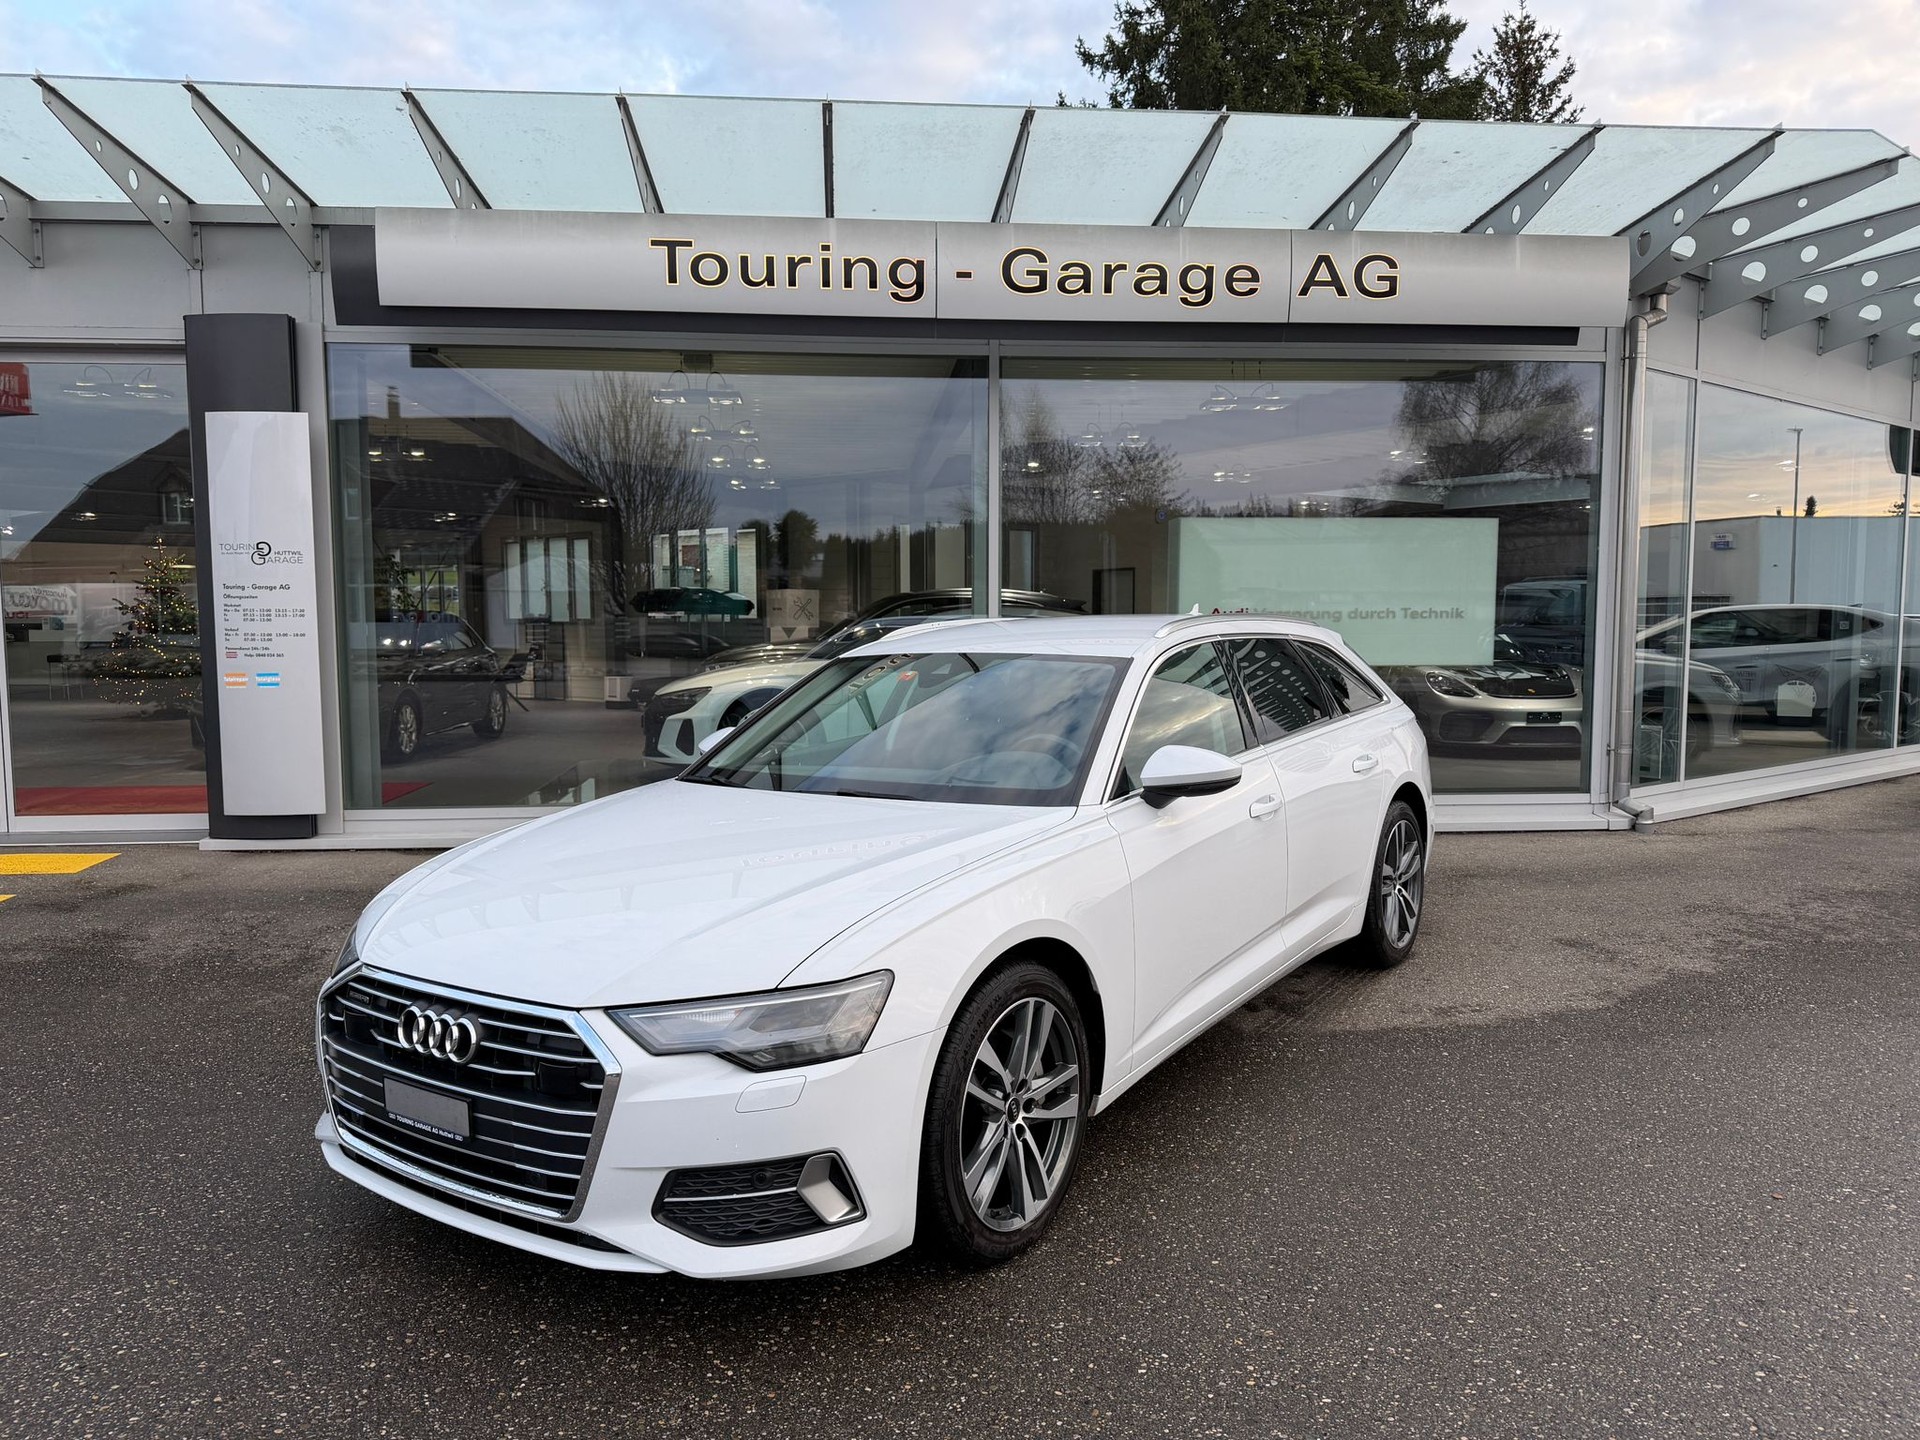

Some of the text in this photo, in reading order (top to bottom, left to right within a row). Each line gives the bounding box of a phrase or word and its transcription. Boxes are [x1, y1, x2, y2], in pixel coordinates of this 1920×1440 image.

[648, 237, 1400, 308] Touring - Garage AG
[251, 550, 304, 566] GARAGE
[1348, 608, 1396, 619] durch
[1400, 608, 1465, 619] Technik
